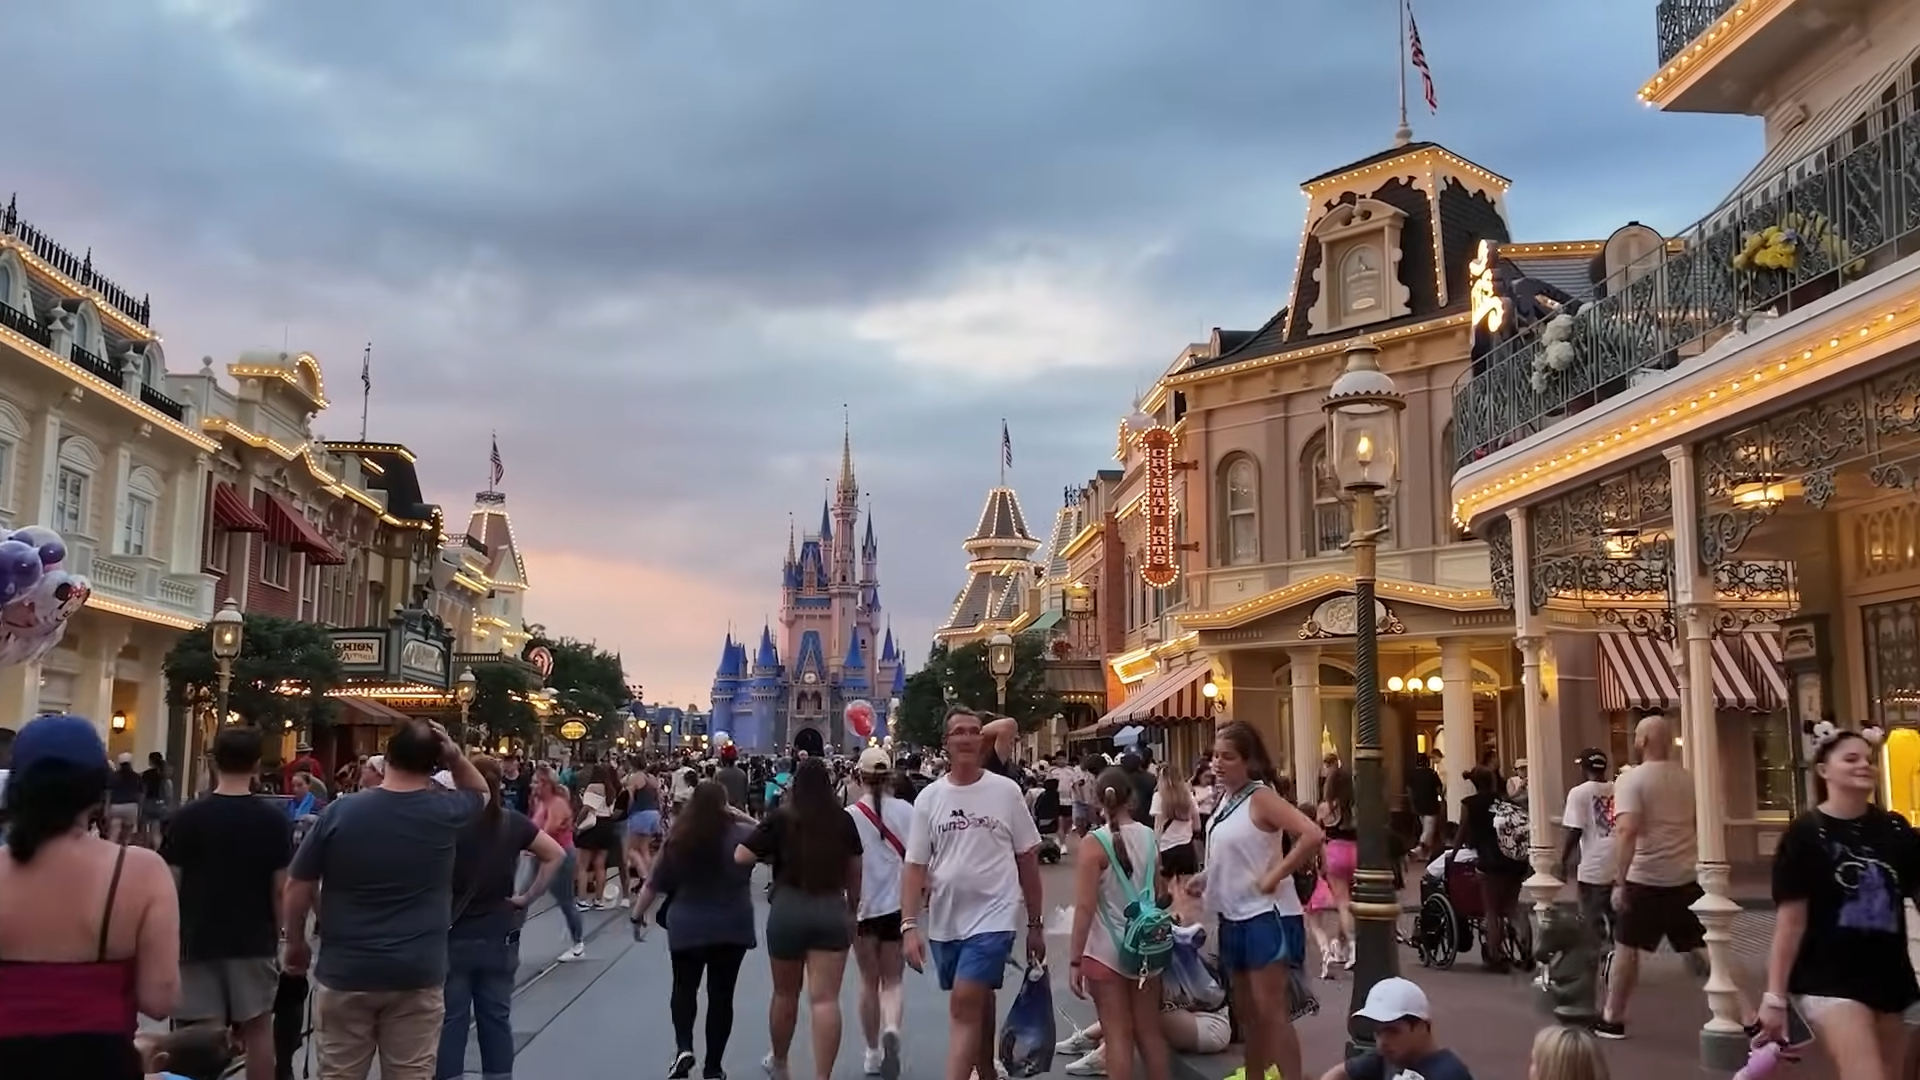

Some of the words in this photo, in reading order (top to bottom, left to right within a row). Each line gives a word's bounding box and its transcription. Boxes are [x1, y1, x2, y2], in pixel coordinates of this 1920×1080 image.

[1152, 448, 1166, 516] CRYSTAL
[1152, 525, 1166, 565] ARTS
[334, 642, 374, 653] SHION
[386, 698, 420, 708] HOUSE
[421, 698, 434, 708] OF
[436, 698, 453, 707] MA
